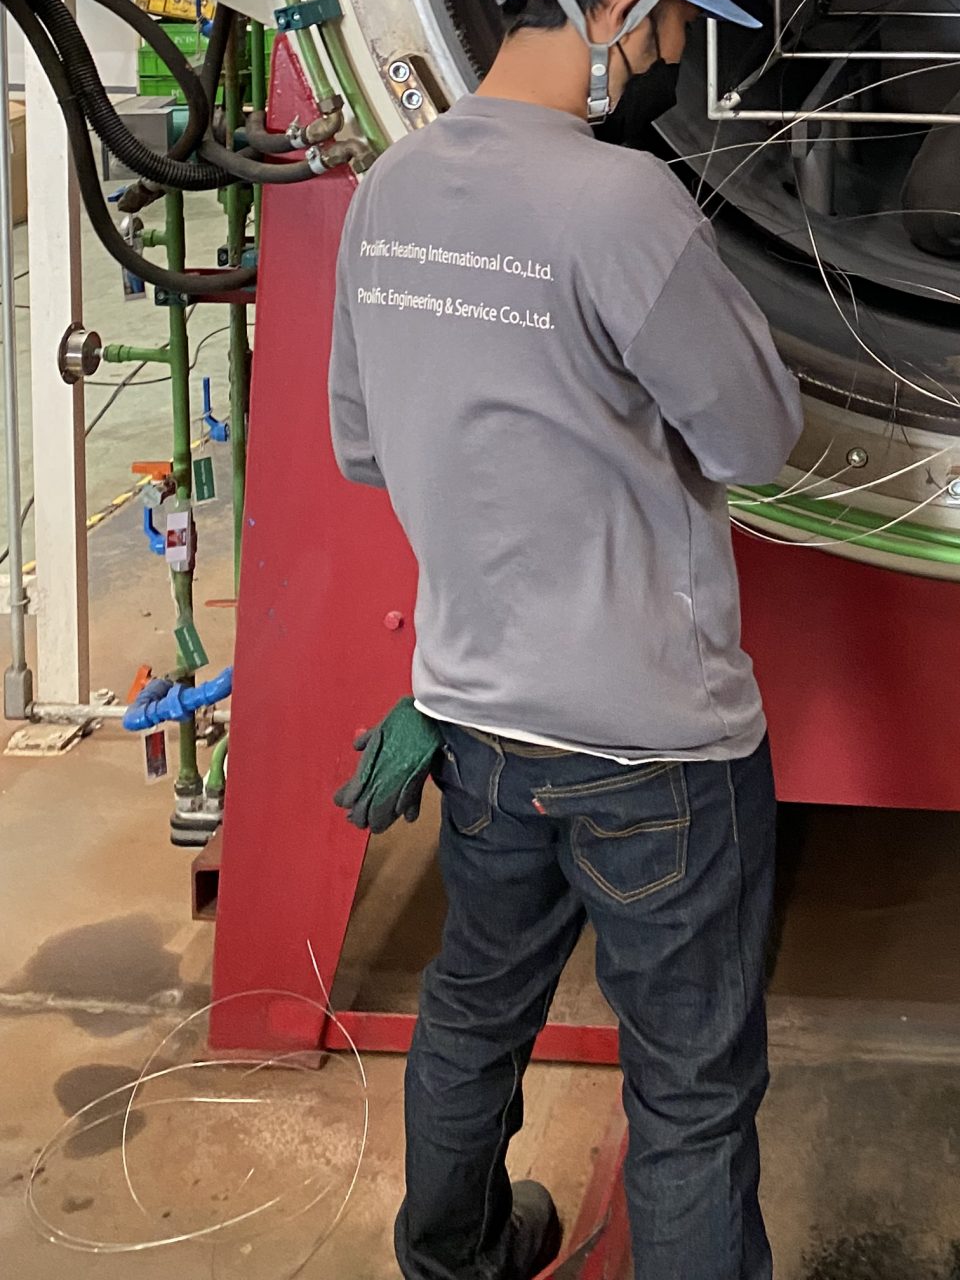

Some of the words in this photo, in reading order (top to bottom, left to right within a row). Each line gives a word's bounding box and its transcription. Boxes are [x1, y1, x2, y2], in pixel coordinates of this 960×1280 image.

[360, 239, 390, 257] Prolific
[391, 241, 427, 264] Heating
[428, 245, 501, 271] International
[503, 256, 554, 281] Co.,Ltd.
[357, 287, 387, 305] Prolific
[388, 289, 443, 316] Engineering
[444, 297, 454, 315] &
[454, 299, 498, 322] Service
[500, 306, 555, 330] Co.,Ltd.
